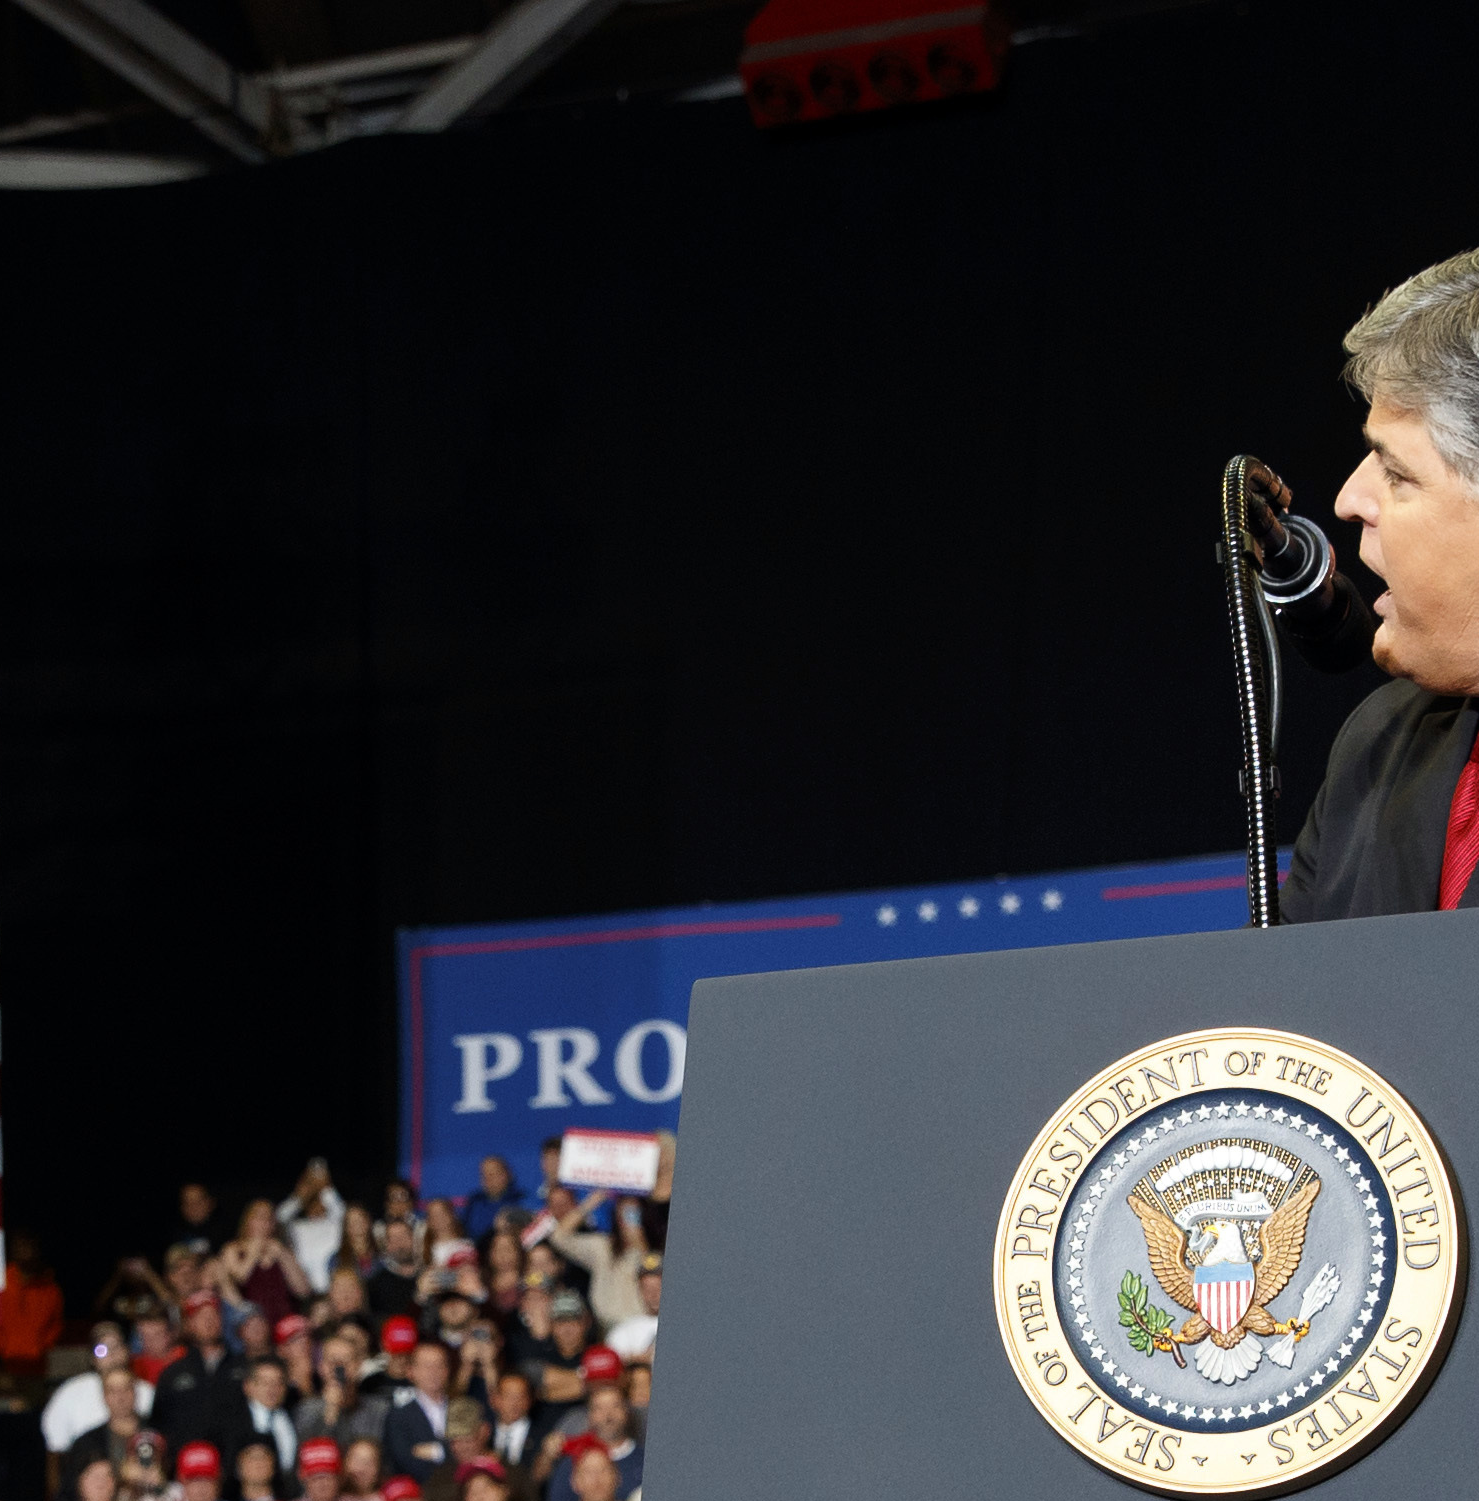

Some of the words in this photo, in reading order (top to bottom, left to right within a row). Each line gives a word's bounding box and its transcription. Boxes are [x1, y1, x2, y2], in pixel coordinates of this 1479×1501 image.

[452, 1019, 687, 1114] PRO
[1224, 1050, 1266, 1076] OF
[1275, 1056, 1333, 1095] THE
[1011, 1048, 1209, 1261] PRESIDENT
[1345, 1086, 1441, 1270] UNITED
[1184, 1203, 1235, 1216] PLURIBUS
[1236, 1203, 1267, 1213] UNUM
[1017, 1280, 1047, 1342] THE
[1033, 1349, 1067, 1386] OF
[1266, 1317, 1422, 1467] STATES
[1068, 1381, 1182, 1471] SEAL
